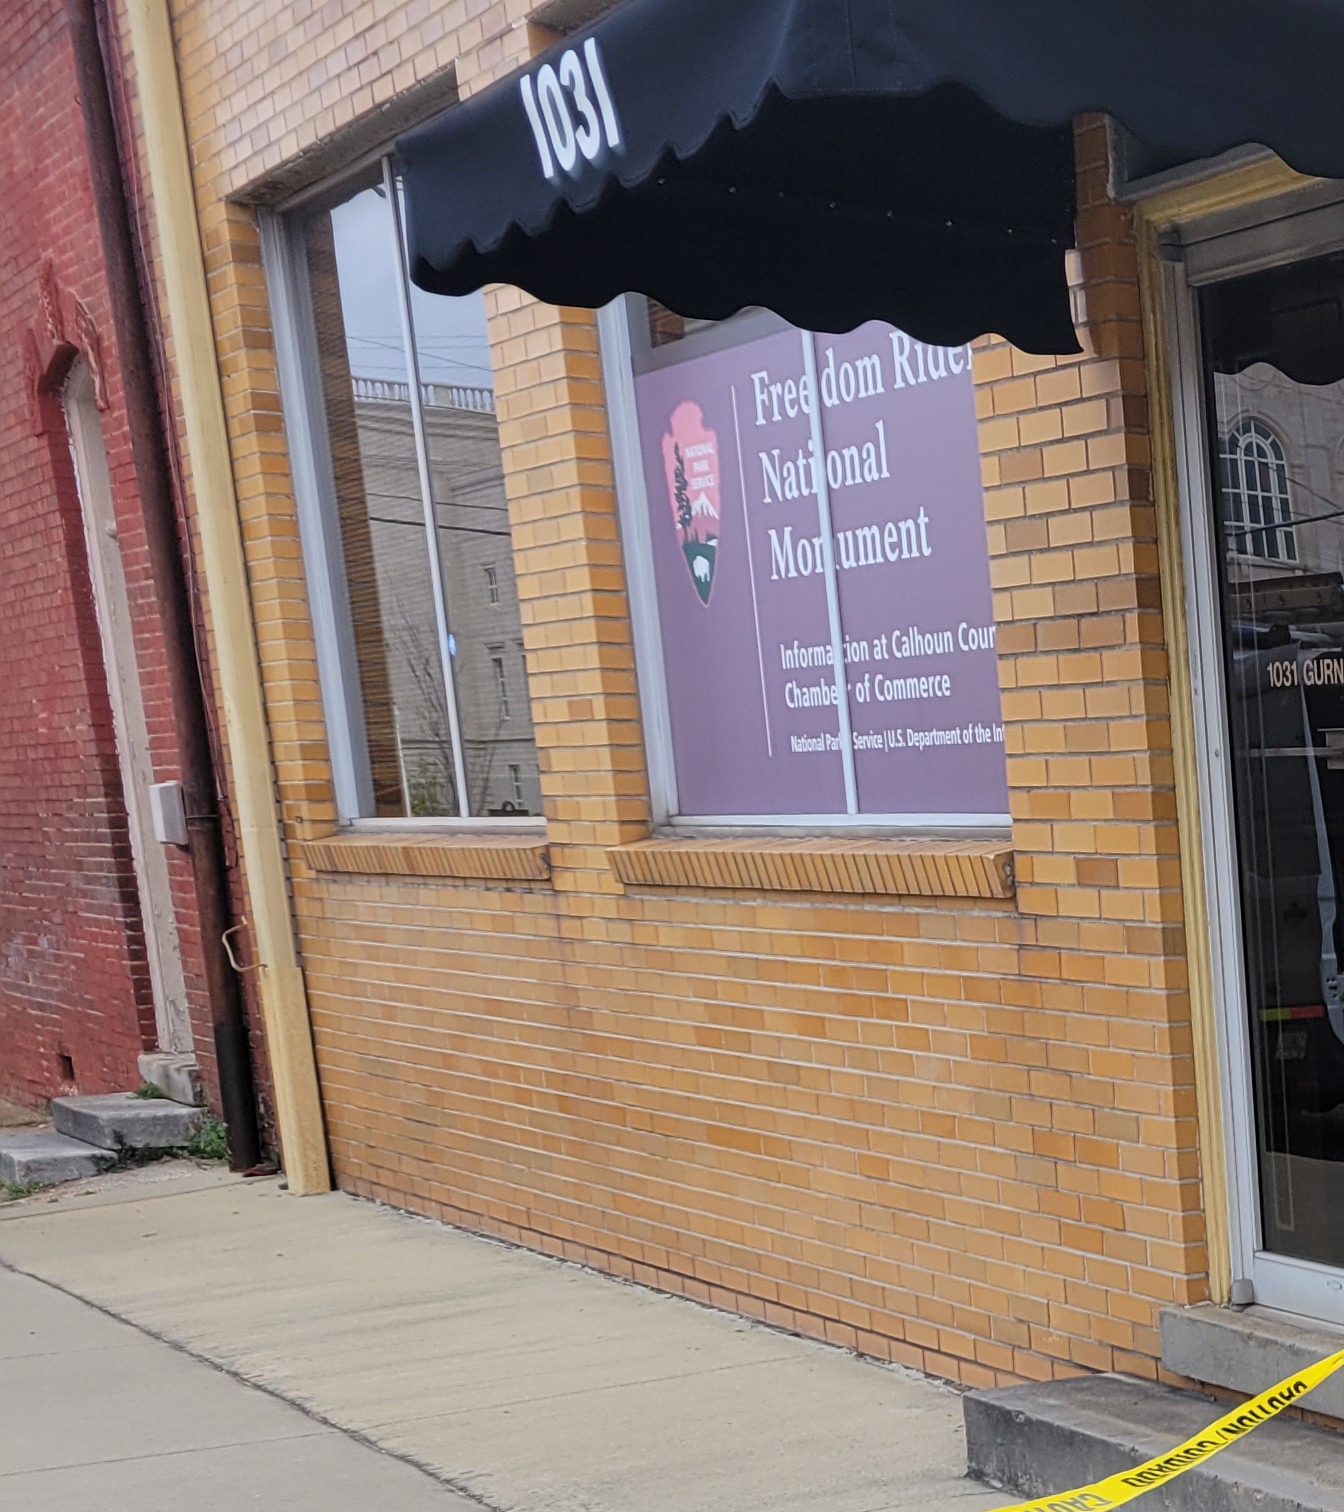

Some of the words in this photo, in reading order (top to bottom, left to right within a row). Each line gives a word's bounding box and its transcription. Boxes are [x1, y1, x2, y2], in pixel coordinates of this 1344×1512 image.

[520, 37, 620, 179] 1031
[751, 347, 885, 426] Freedom
[758, 419, 891, 504] National
[873, 633, 889, 660] at
[892, 626, 954, 659] Calhoun
[785, 678, 852, 709] Chambe
[856, 673, 871, 703] of
[874, 673, 951, 701] Commerce
[1266, 661, 1298, 687] 1031
[790, 732, 826, 752] National
[825, 731, 842, 750] Par
[853, 731, 883, 750] Service
[907, 726, 962, 751] Department
[963, 722, 974, 744] of
[974, 722, 991, 743] the
